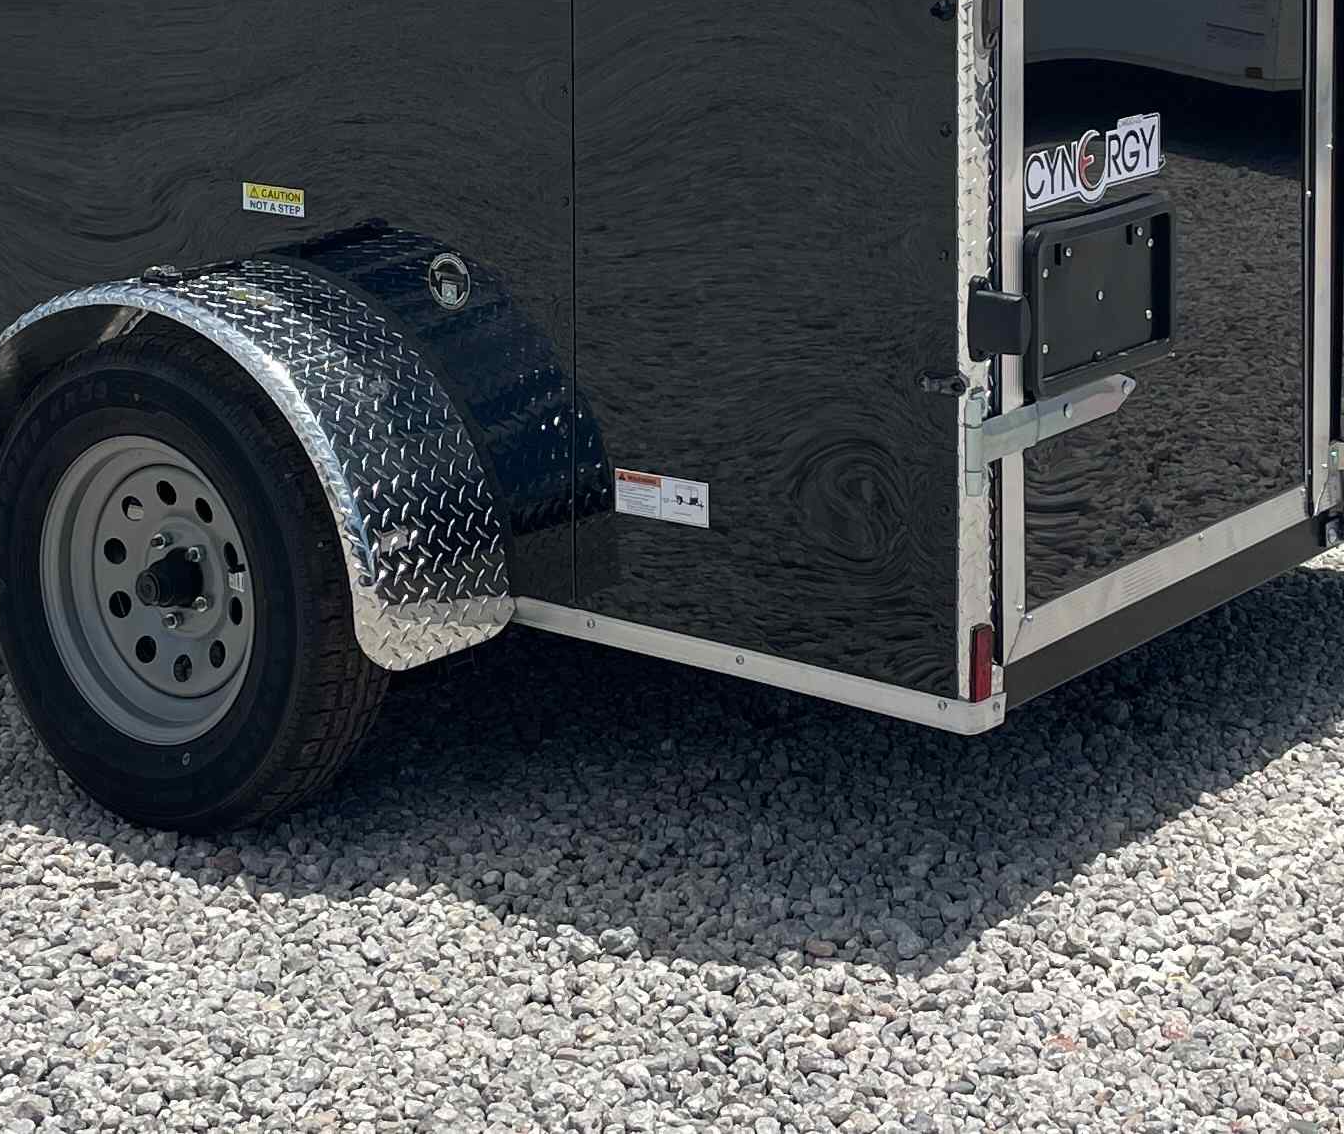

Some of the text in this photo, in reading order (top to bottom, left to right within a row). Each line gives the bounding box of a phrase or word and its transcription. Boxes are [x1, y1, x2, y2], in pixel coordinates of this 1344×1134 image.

[1026, 123, 1156, 199] CYNERGY
[261, 188, 301, 203] CAUTION
[250, 200, 268, 211] NOT
[278, 205, 301, 215] STEP
